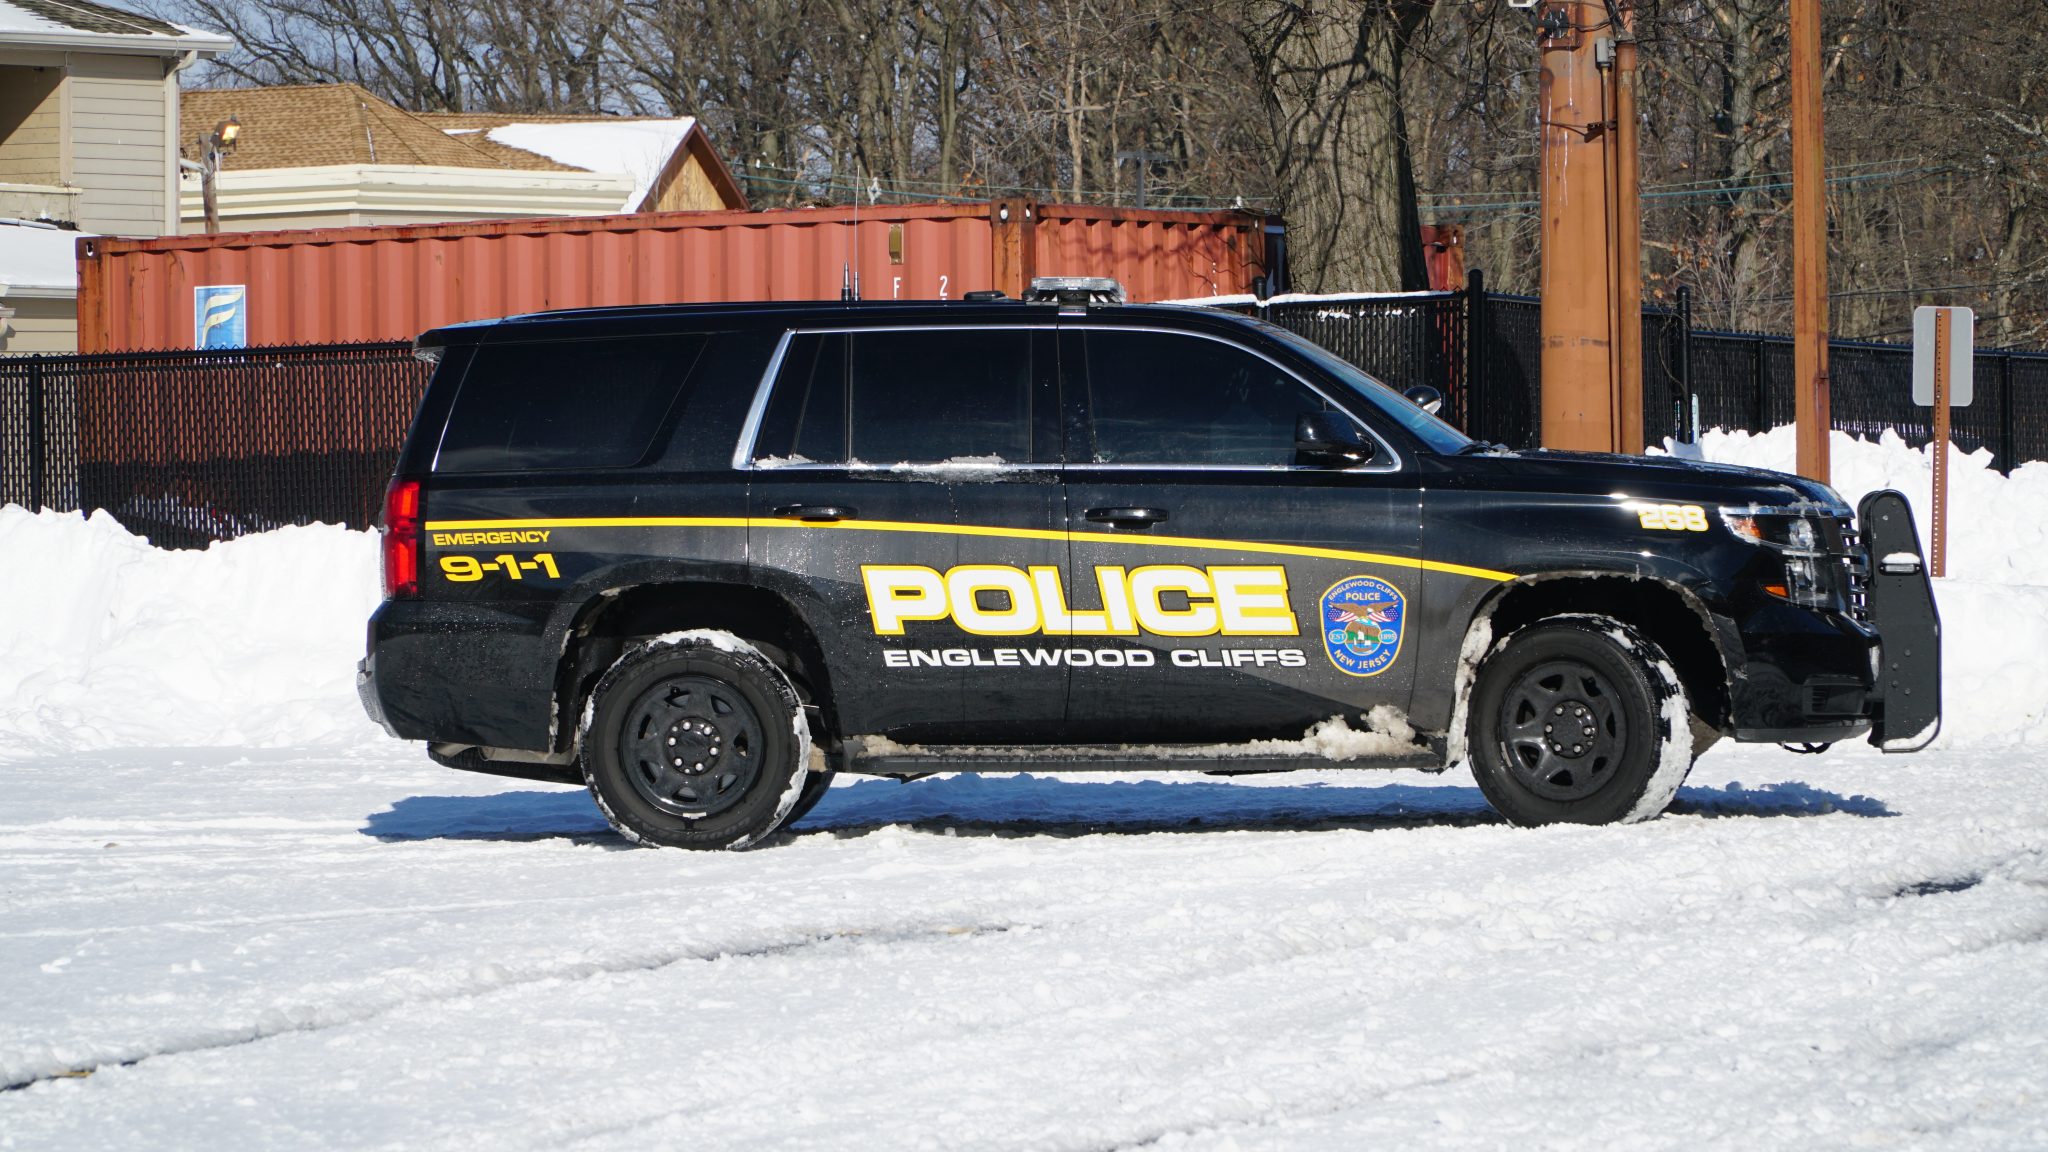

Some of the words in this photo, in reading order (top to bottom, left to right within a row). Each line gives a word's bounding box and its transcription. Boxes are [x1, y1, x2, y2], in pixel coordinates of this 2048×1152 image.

[893, 277, 901, 299] F
[939, 275, 948, 297] 2
[1637, 504, 1709, 532] 268
[432, 530, 550, 546] EMERGENCY
[439, 553, 561, 582] 9-1-1
[1328, 580, 1375, 600] ENGLEWOOD
[1376, 583, 1398, 600] CLIFFS
[1345, 592, 1381, 600] POLICE
[860, 565, 1300, 637] POLICE
[883, 649, 1156, 668] ENGLEWOOD
[1170, 649, 1307, 668] CLIFFS
[1334, 649, 1355, 667] NEW
[1357, 649, 1391, 669] JERSEY
